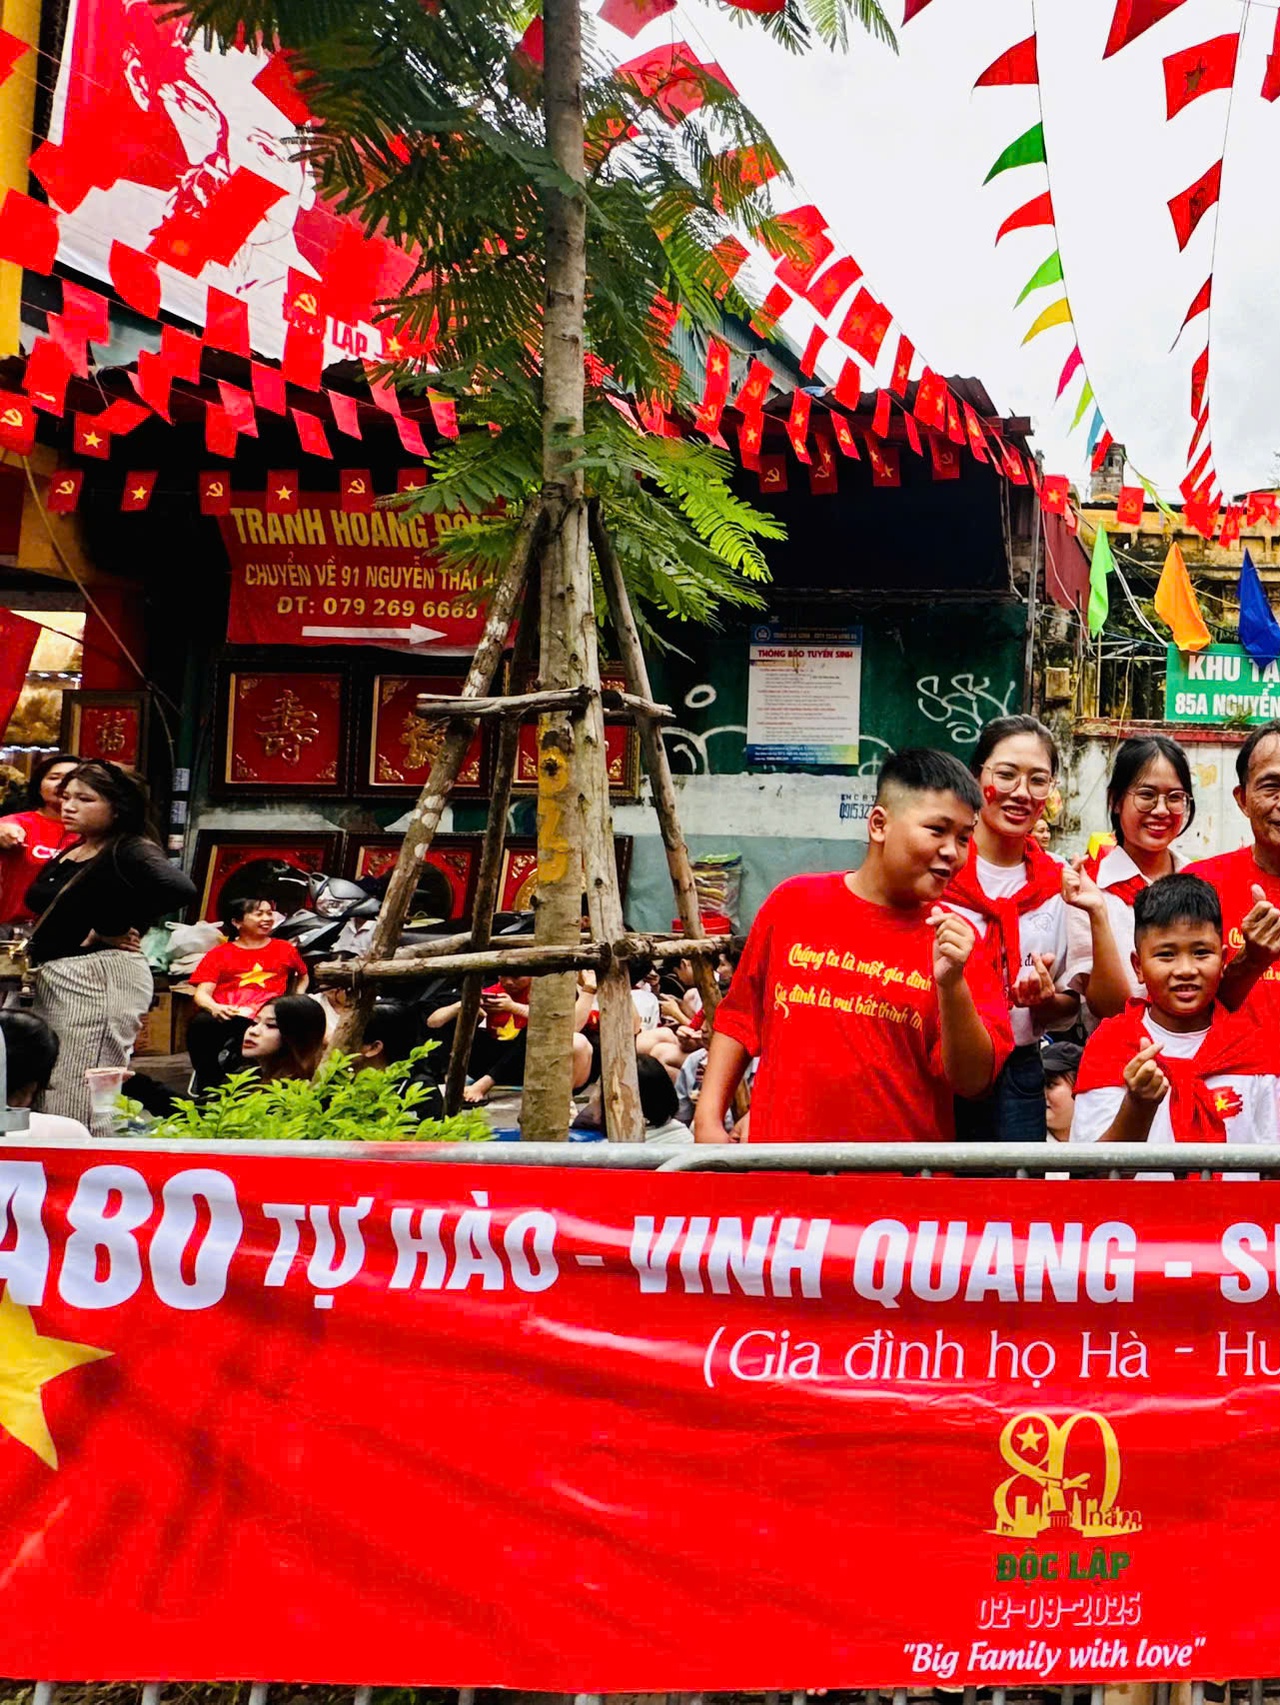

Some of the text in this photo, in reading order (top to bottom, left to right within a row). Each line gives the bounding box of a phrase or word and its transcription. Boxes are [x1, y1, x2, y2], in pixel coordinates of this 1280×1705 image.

[230, 507, 326, 545] TRANH
[245, 552, 311, 587] CHUYỂN
[317, 555, 337, 587] VỀ
[341, 566, 359, 587] 91
[365, 555, 435, 590] NGUYỄN
[277, 597, 315, 614] ĐT:
[323, 597, 366, 616] 079
[373, 599, 416, 617] 269
[758, 649, 786, 658] THÔNG
[808, 648, 833, 659] TUYỂN
[835, 651, 854, 659] SINH
[1188, 655, 1241, 681] KHU
[1175, 692, 1208, 716] 85A
[788, 943, 932, 992] Chúng ta là một gia đình
[789, 983, 816, 1006] đình
[818, 988, 832, 1008] là
[833, 998, 853, 1013] vui
[855, 994, 878, 1017] bất
[0, 1161, 243, 1311] A80
[262, 1196, 377, 1309] TỰ
[391, 1191, 560, 1293] HÀO
[628, 1214, 831, 1300] VINH
[853, 1219, 1137, 1309] QUANG
[1164, 1260, 1192, 1278] -
[703, 1326, 822, 1389] (Gia
[844, 1328, 965, 1381] đình
[987, 1329, 1057, 1389] họ
[1080, 1330, 1150, 1379] Hà
[996, 1546, 1131, 1587] ĐỘC LẬP
[902, 1636, 1207, 1679] "Big Family with love"
